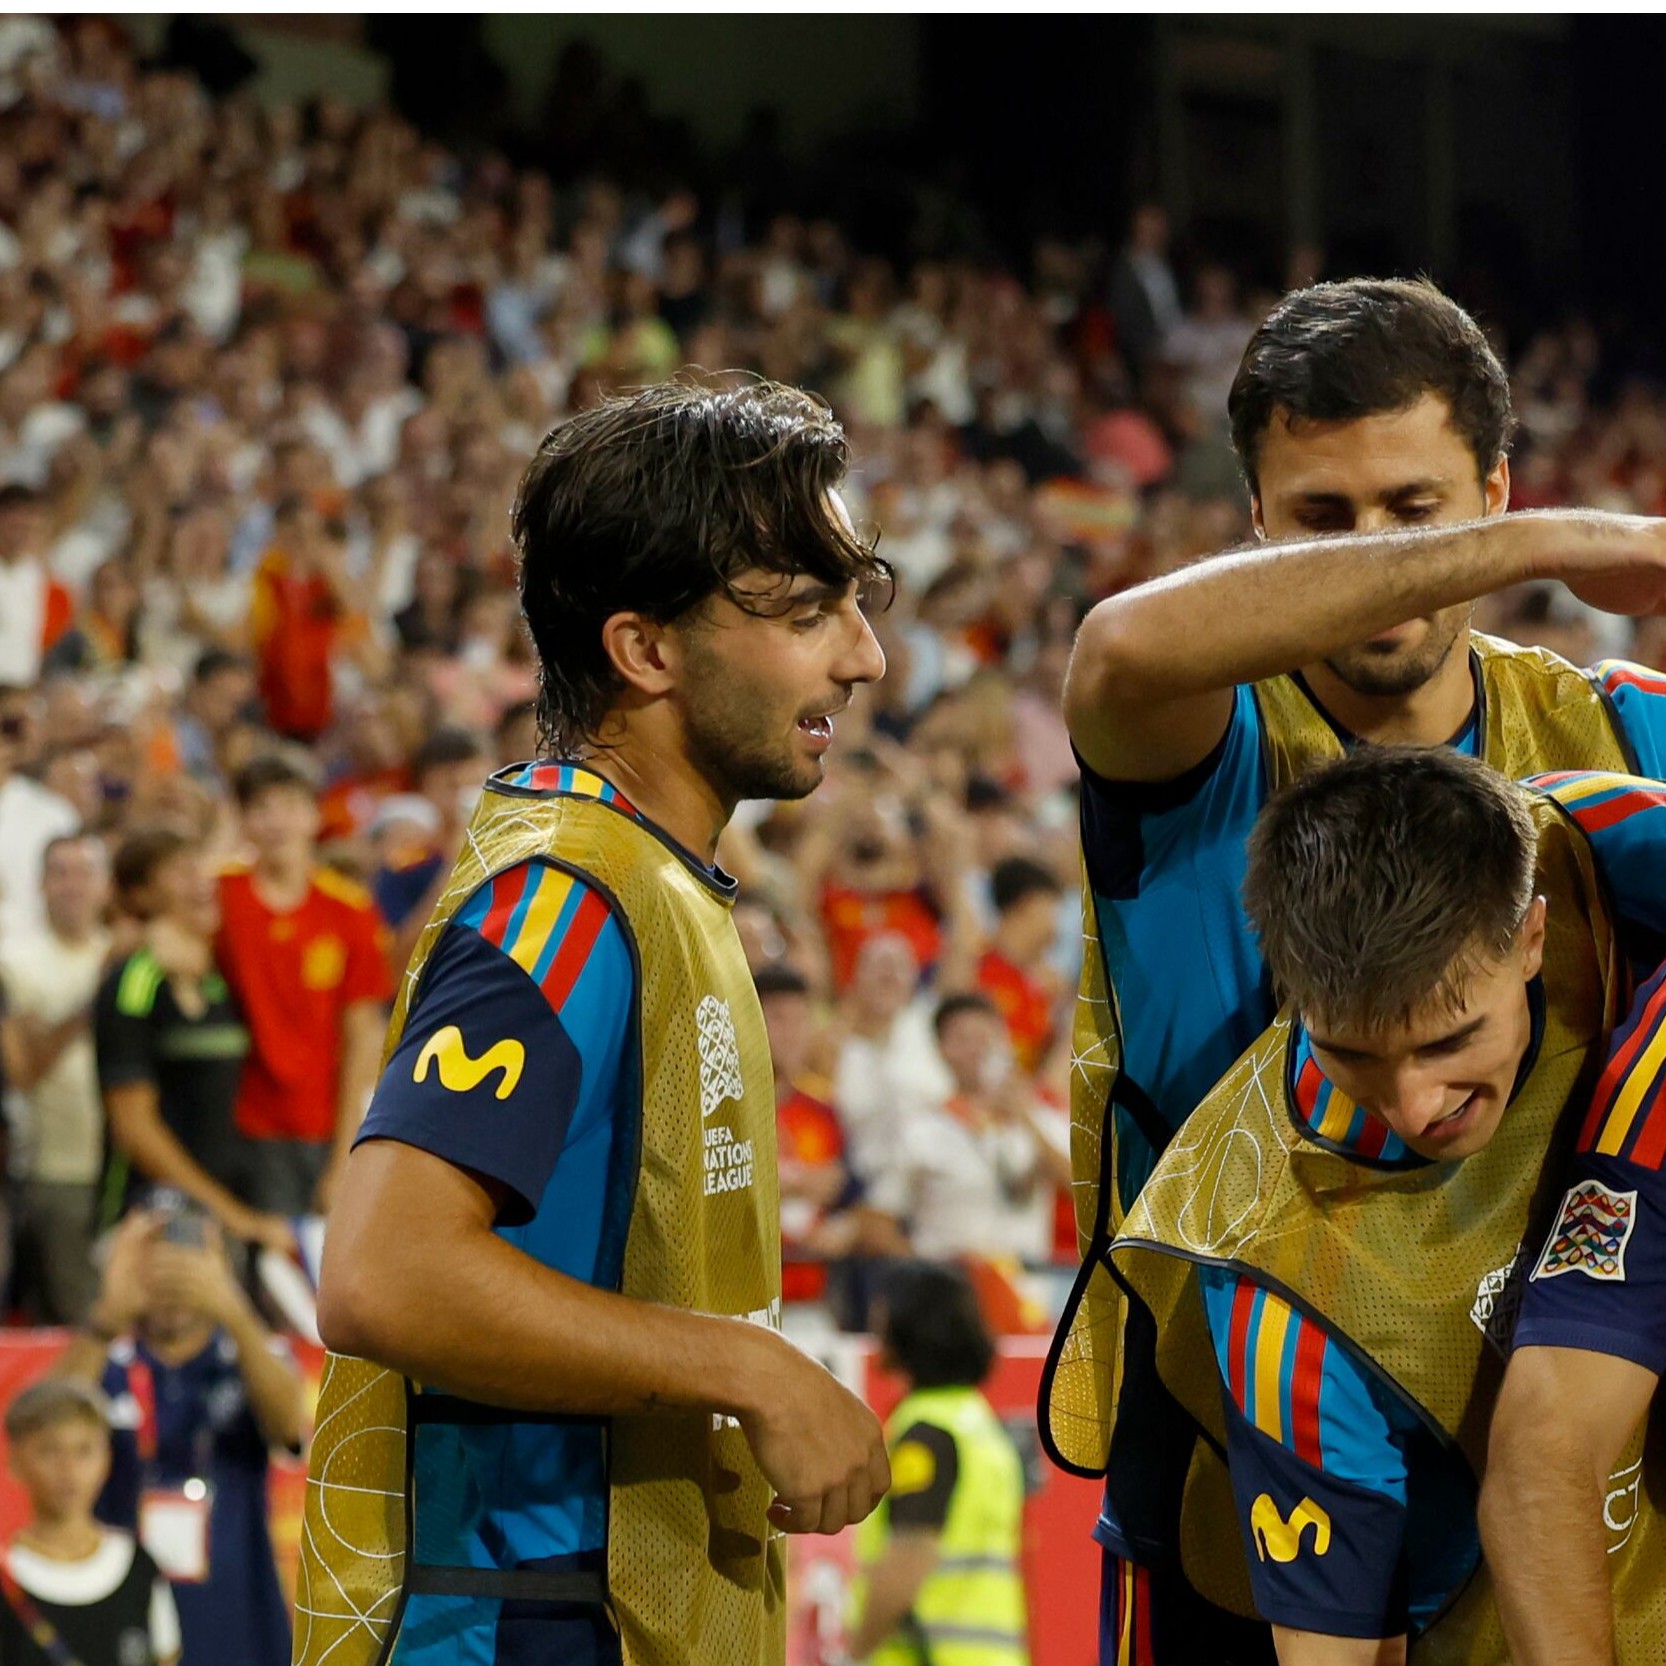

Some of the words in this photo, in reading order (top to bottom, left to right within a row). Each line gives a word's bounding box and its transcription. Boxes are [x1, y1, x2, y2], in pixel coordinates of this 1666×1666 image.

[704, 1126, 734, 1147] UEFA
[703, 1139, 753, 1171] NATIONS
[703, 1163, 753, 1197] LEAGUE
